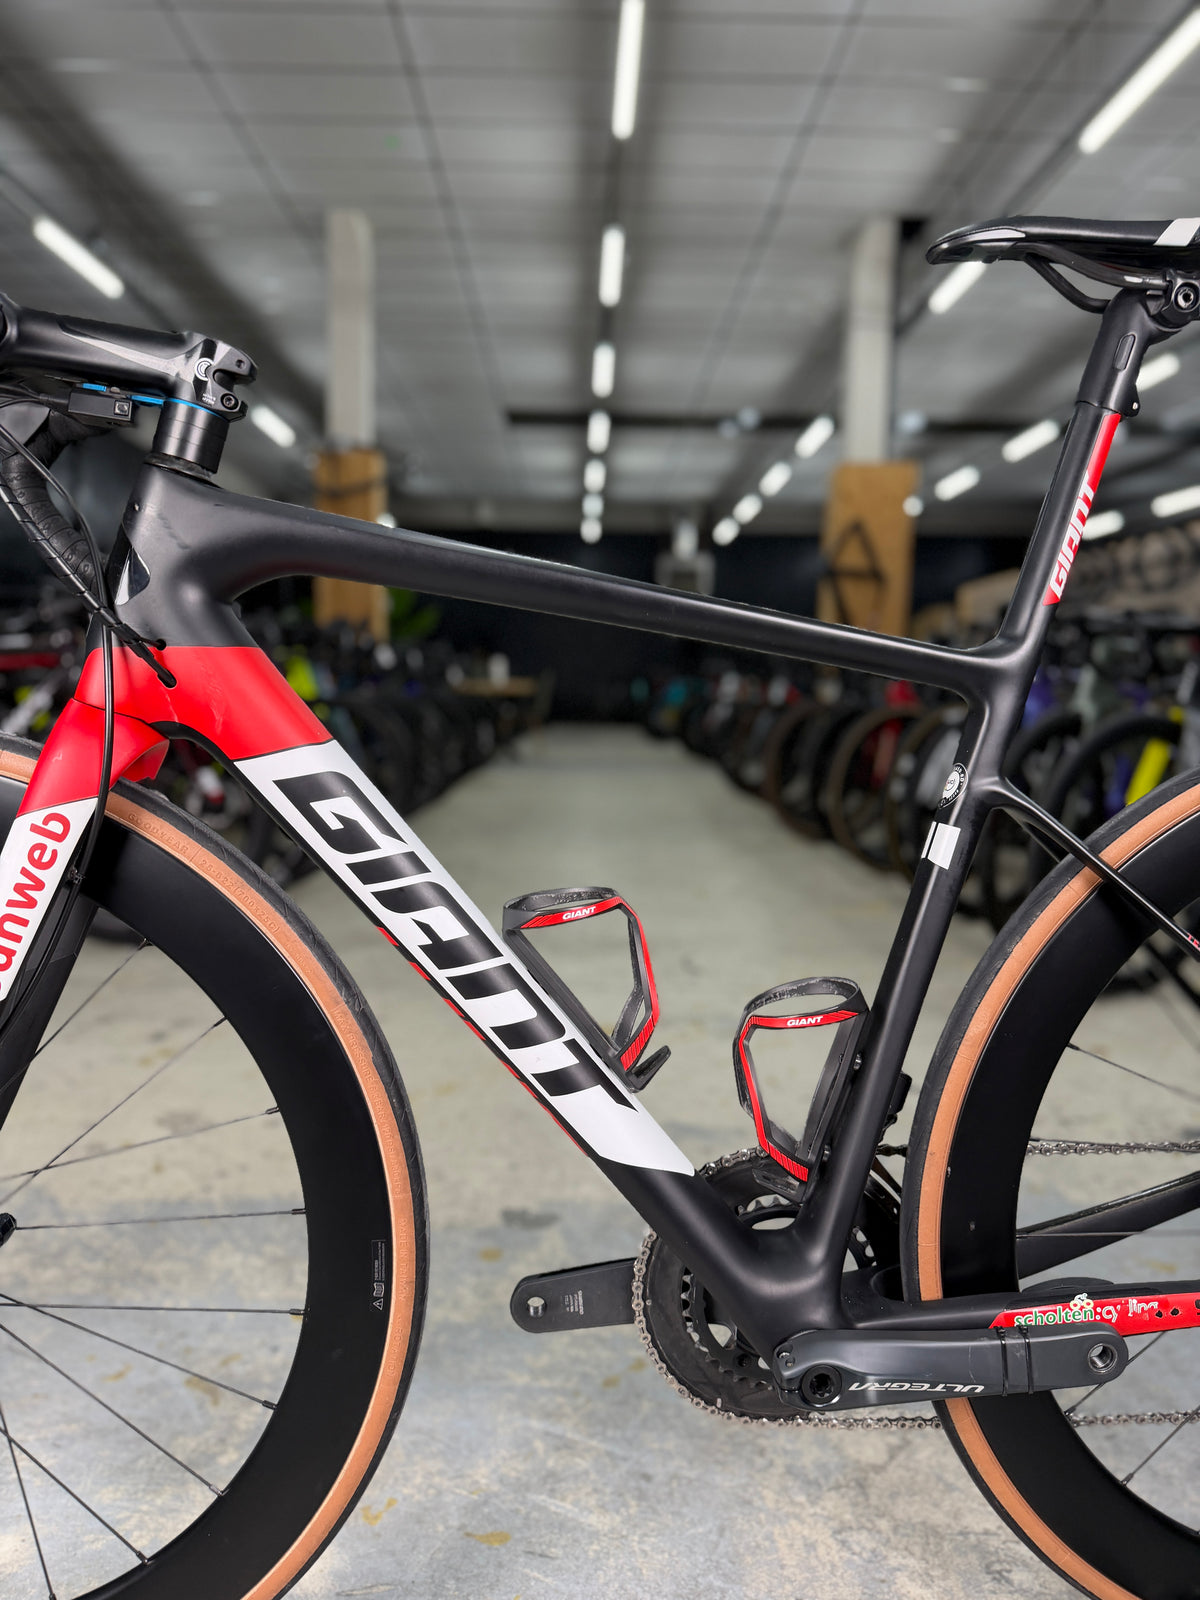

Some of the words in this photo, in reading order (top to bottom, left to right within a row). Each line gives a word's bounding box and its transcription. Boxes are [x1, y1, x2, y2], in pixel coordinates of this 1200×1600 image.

[1050, 470, 1095, 600] GIANT
[0, 812, 71, 990] nweb
[562, 906, 597, 920] GIANT
[272, 770, 640, 1113] GIANT
[786, 1016, 823, 1027] GIANT
[848, 1382, 985, 1393] ULTEGRA
